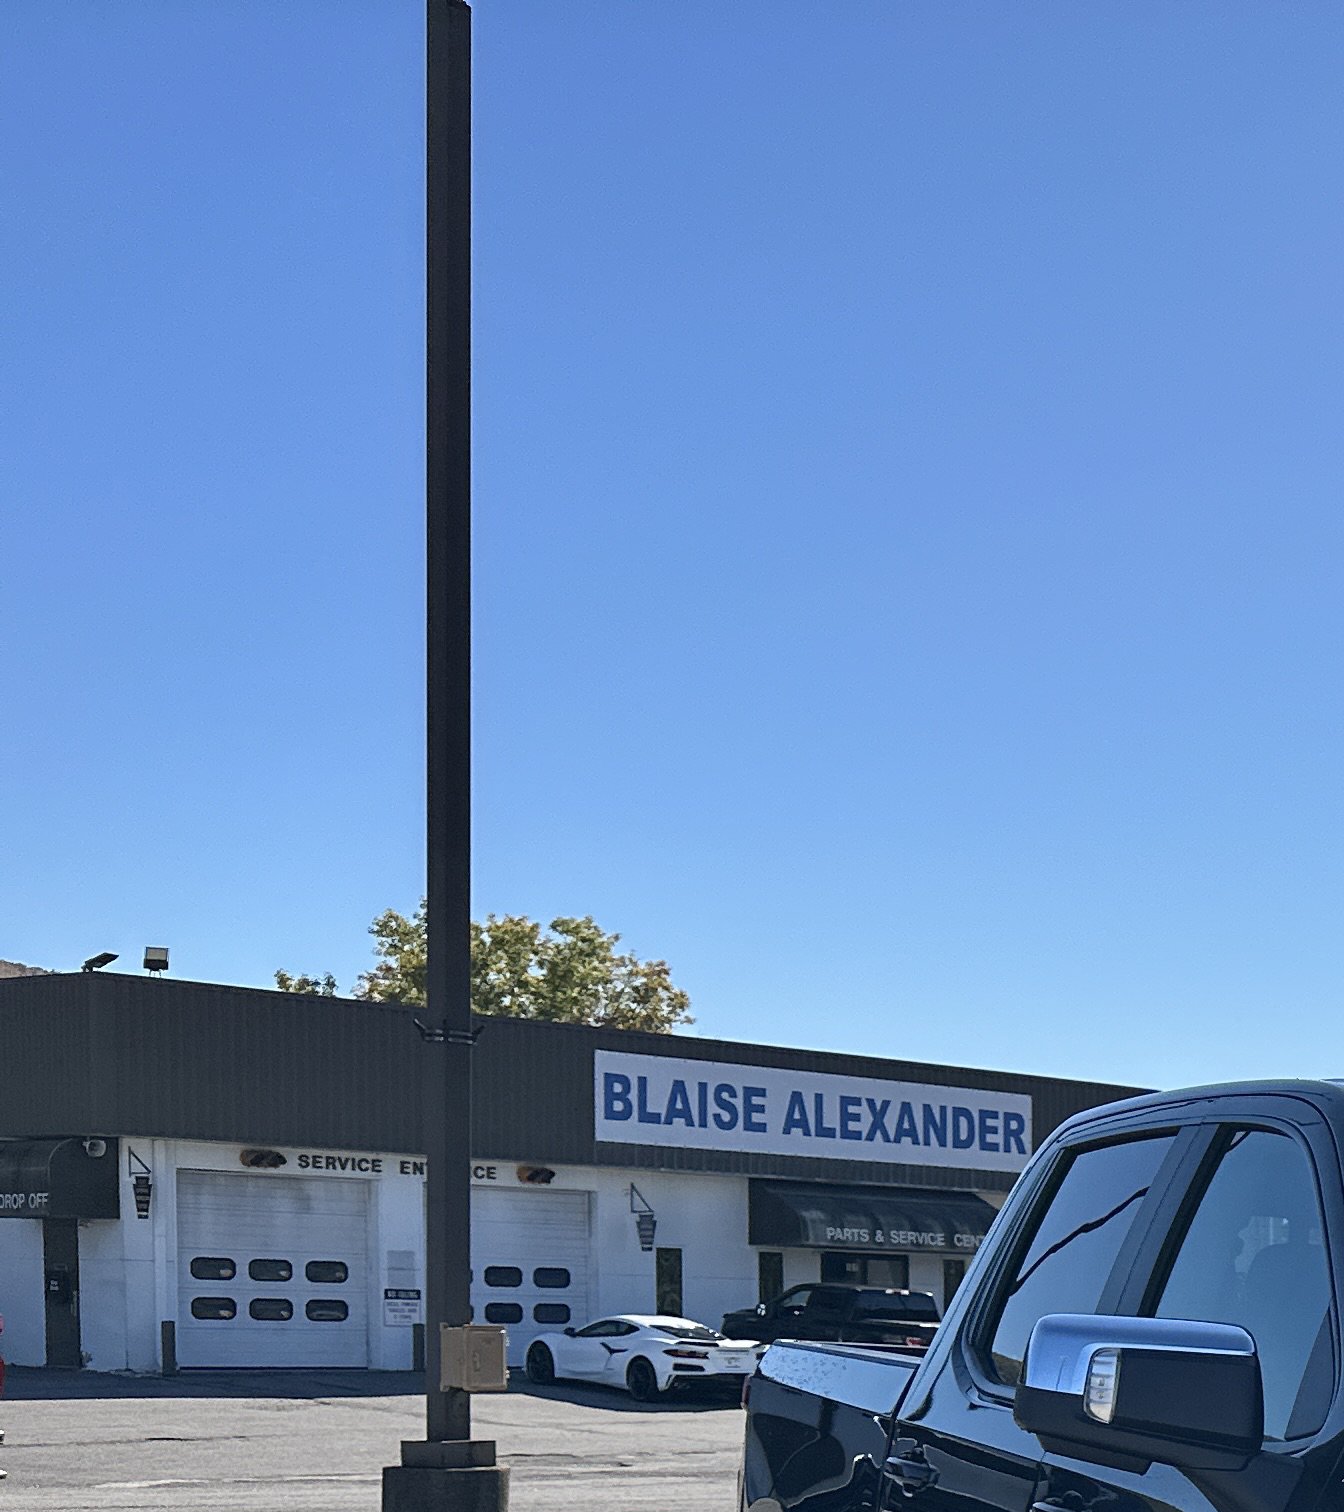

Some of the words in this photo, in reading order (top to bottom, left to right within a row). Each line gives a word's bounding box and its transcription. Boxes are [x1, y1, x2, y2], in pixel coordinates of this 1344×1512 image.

[603, 1071, 768, 1134] BLAISE
[782, 1090, 1028, 1156] ALEXANDER
[297, 1153, 383, 1173] SERVICE
[28, 1192, 49, 1209] OFF
[826, 1226, 870, 1243] PARTS
[875, 1229, 885, 1243] &
[889, 1230, 945, 1247] SERVICE
